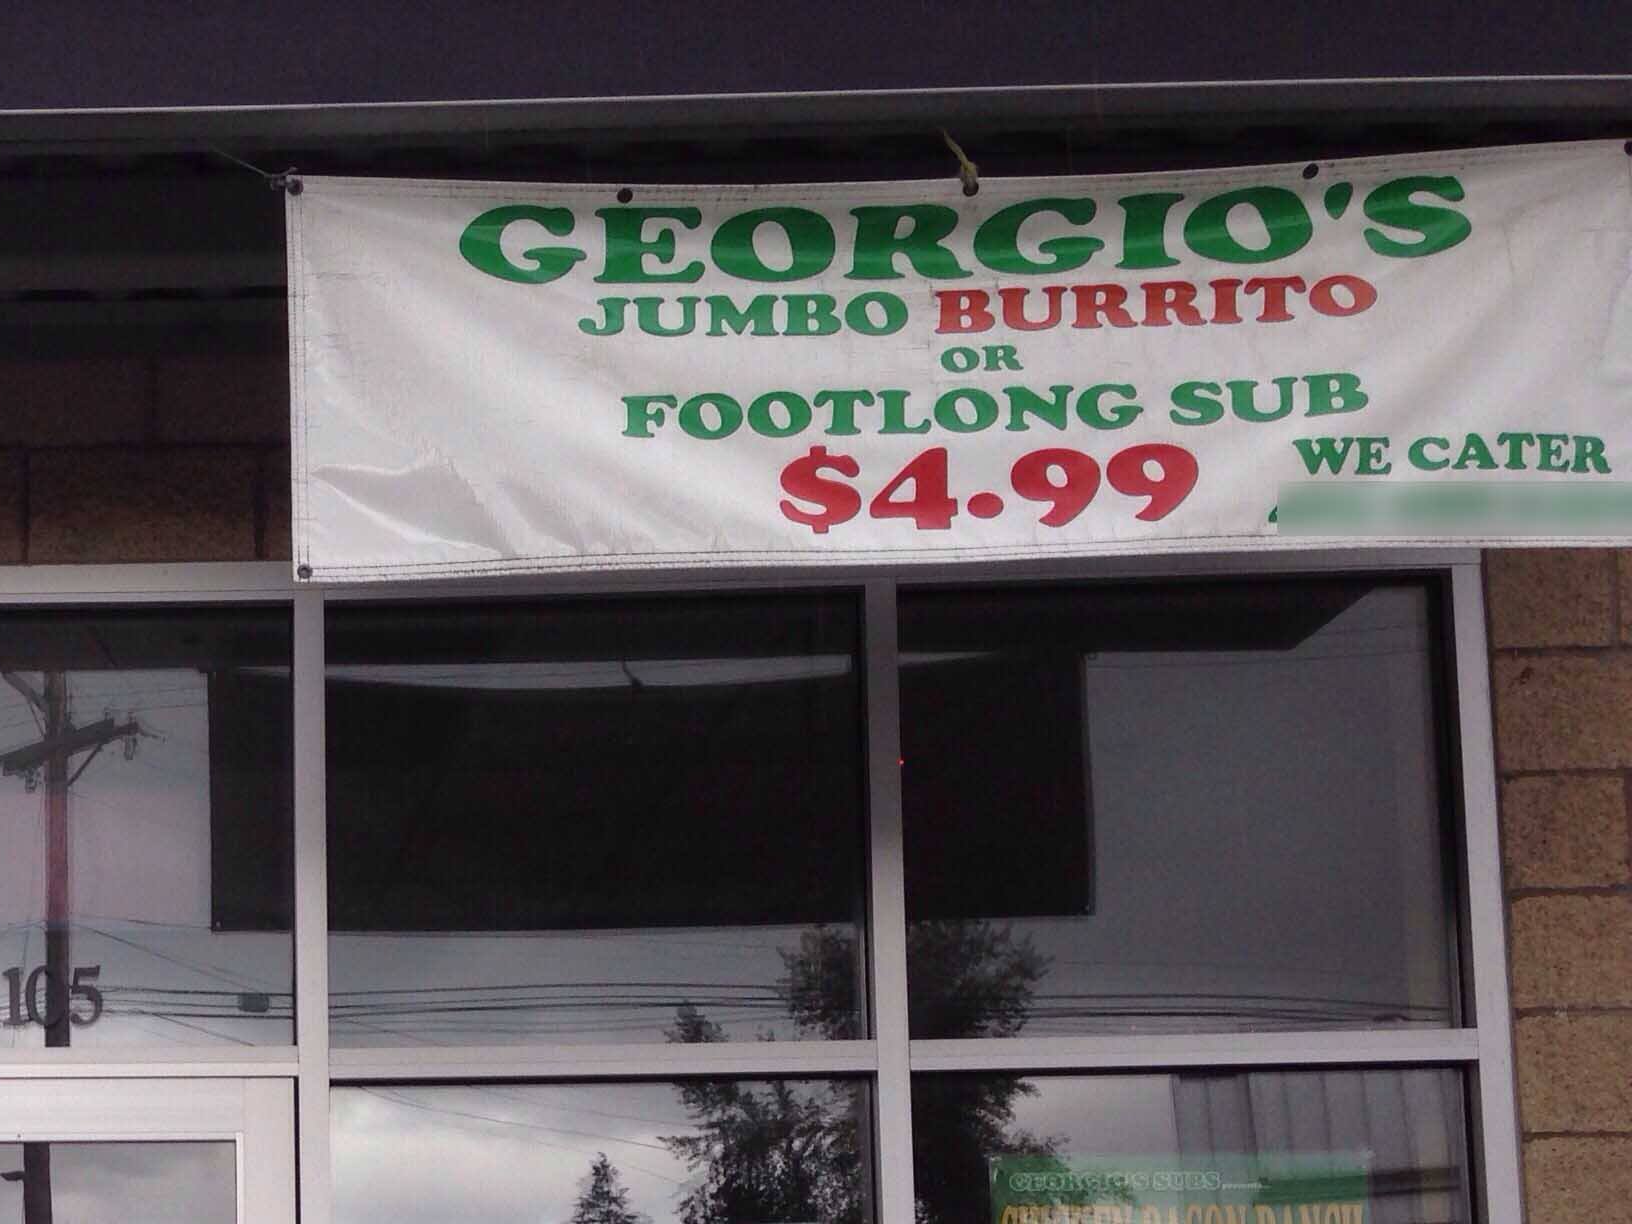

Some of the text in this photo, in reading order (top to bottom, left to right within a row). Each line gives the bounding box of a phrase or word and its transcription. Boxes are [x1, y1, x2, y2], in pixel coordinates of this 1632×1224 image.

[458, 175, 1474, 286] GEORGIO'S
[577, 274, 1379, 338] JUMBO BURRITO
[939, 343, 1024, 376] OR
[619, 370, 1369, 440] FOOTLONG SUB
[1292, 431, 1612, 476] WE CATER
[779, 443, 1201, 534] $4.99
[2, 964, 103, 1029] 105
